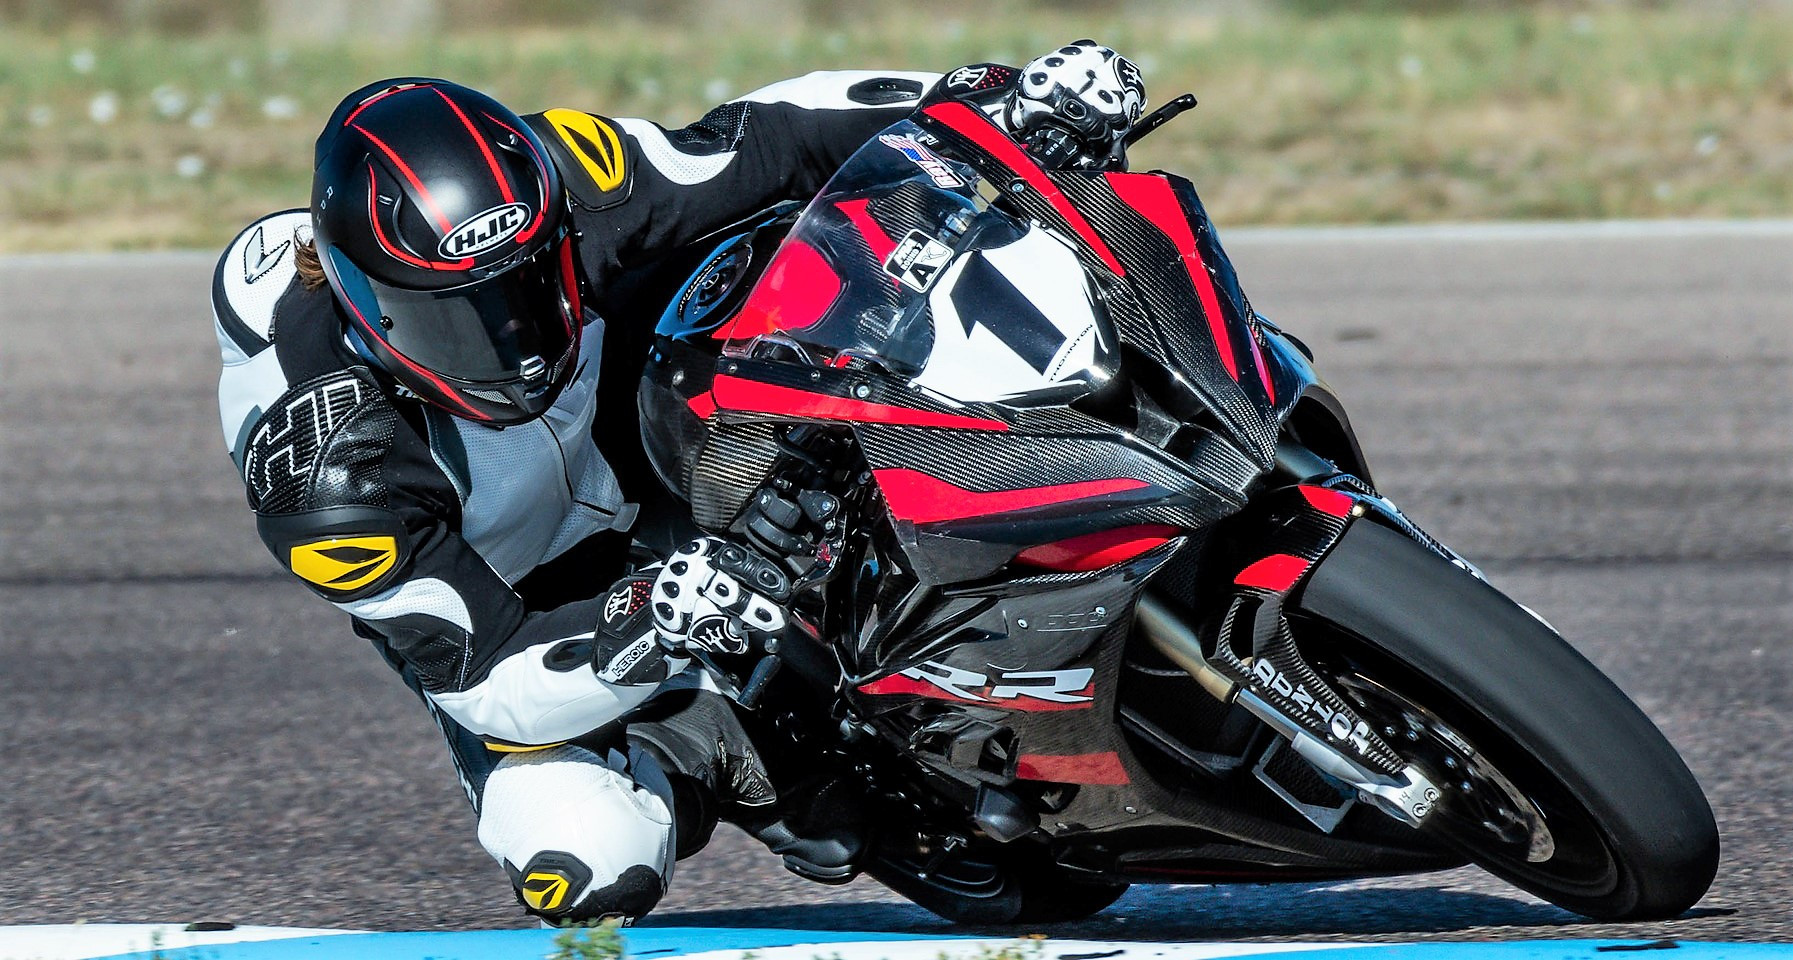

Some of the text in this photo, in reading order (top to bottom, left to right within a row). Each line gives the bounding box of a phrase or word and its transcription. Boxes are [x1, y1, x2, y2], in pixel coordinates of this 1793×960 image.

[454, 207, 519, 253] HJC
[909, 263, 938, 288] A
[949, 251, 1067, 377] 1
[1049, 323, 1093, 383] THORNTON
[613, 640, 650, 677] HEROIC
[899, 660, 1094, 703] RR
[1253, 658, 1370, 755] DUNLOP
